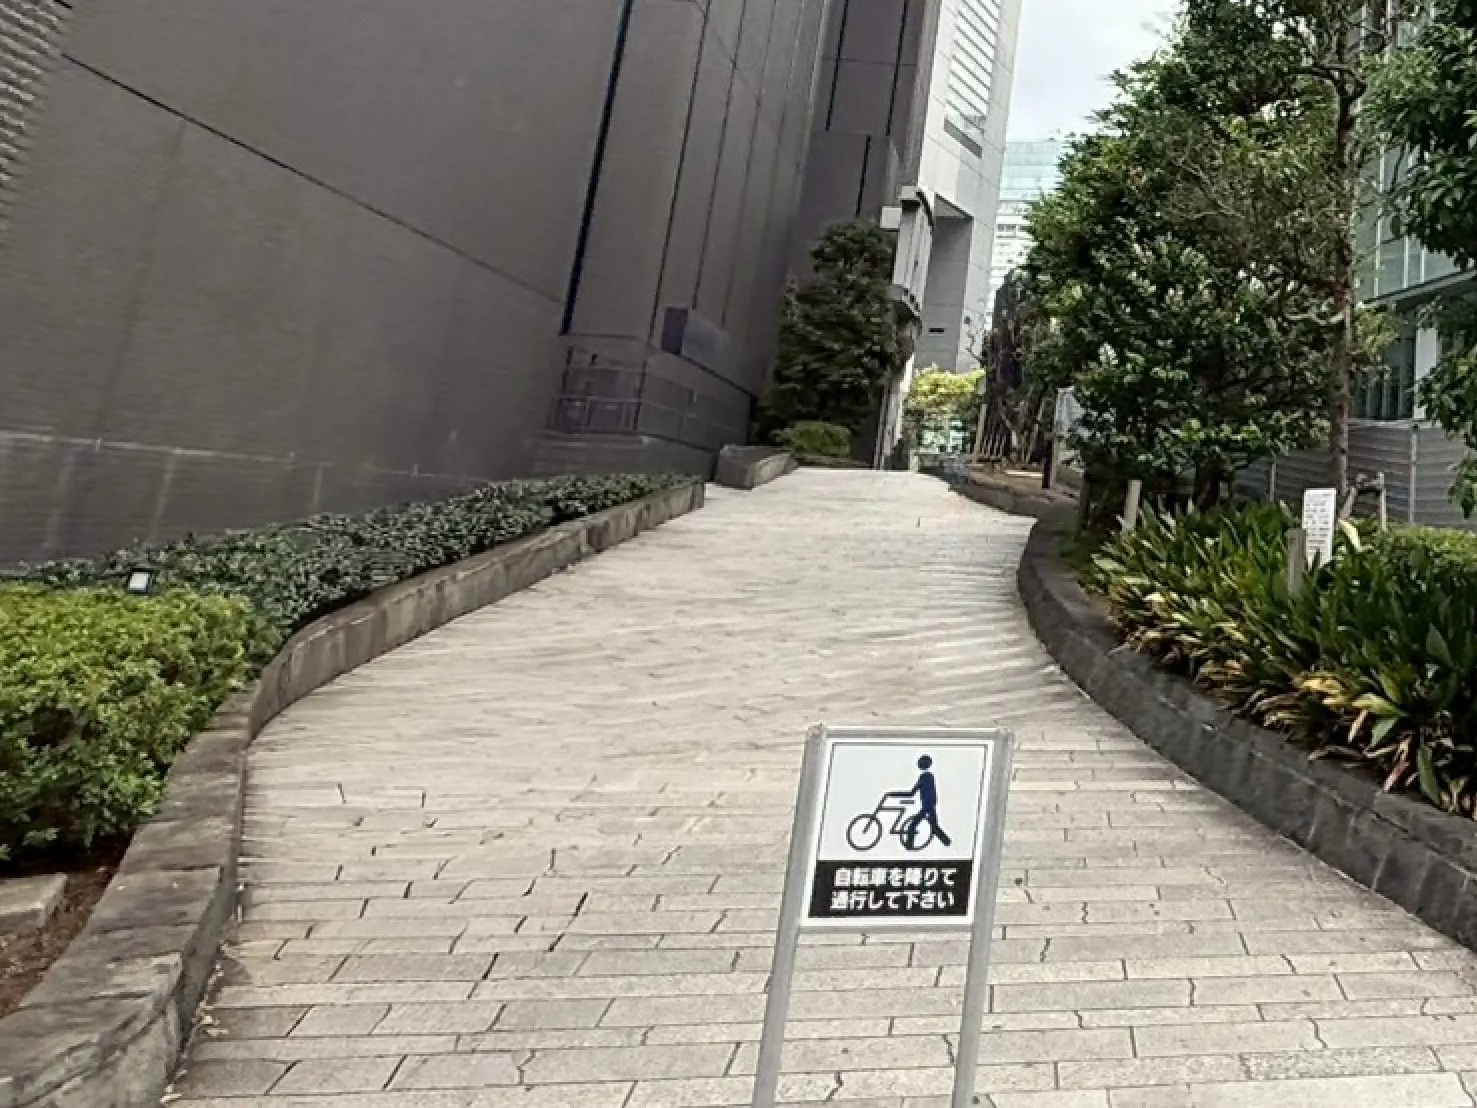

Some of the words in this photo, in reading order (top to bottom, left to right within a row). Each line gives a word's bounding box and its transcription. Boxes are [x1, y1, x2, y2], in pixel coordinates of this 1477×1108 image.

[830, 890, 955, 910] 通行して下さい
